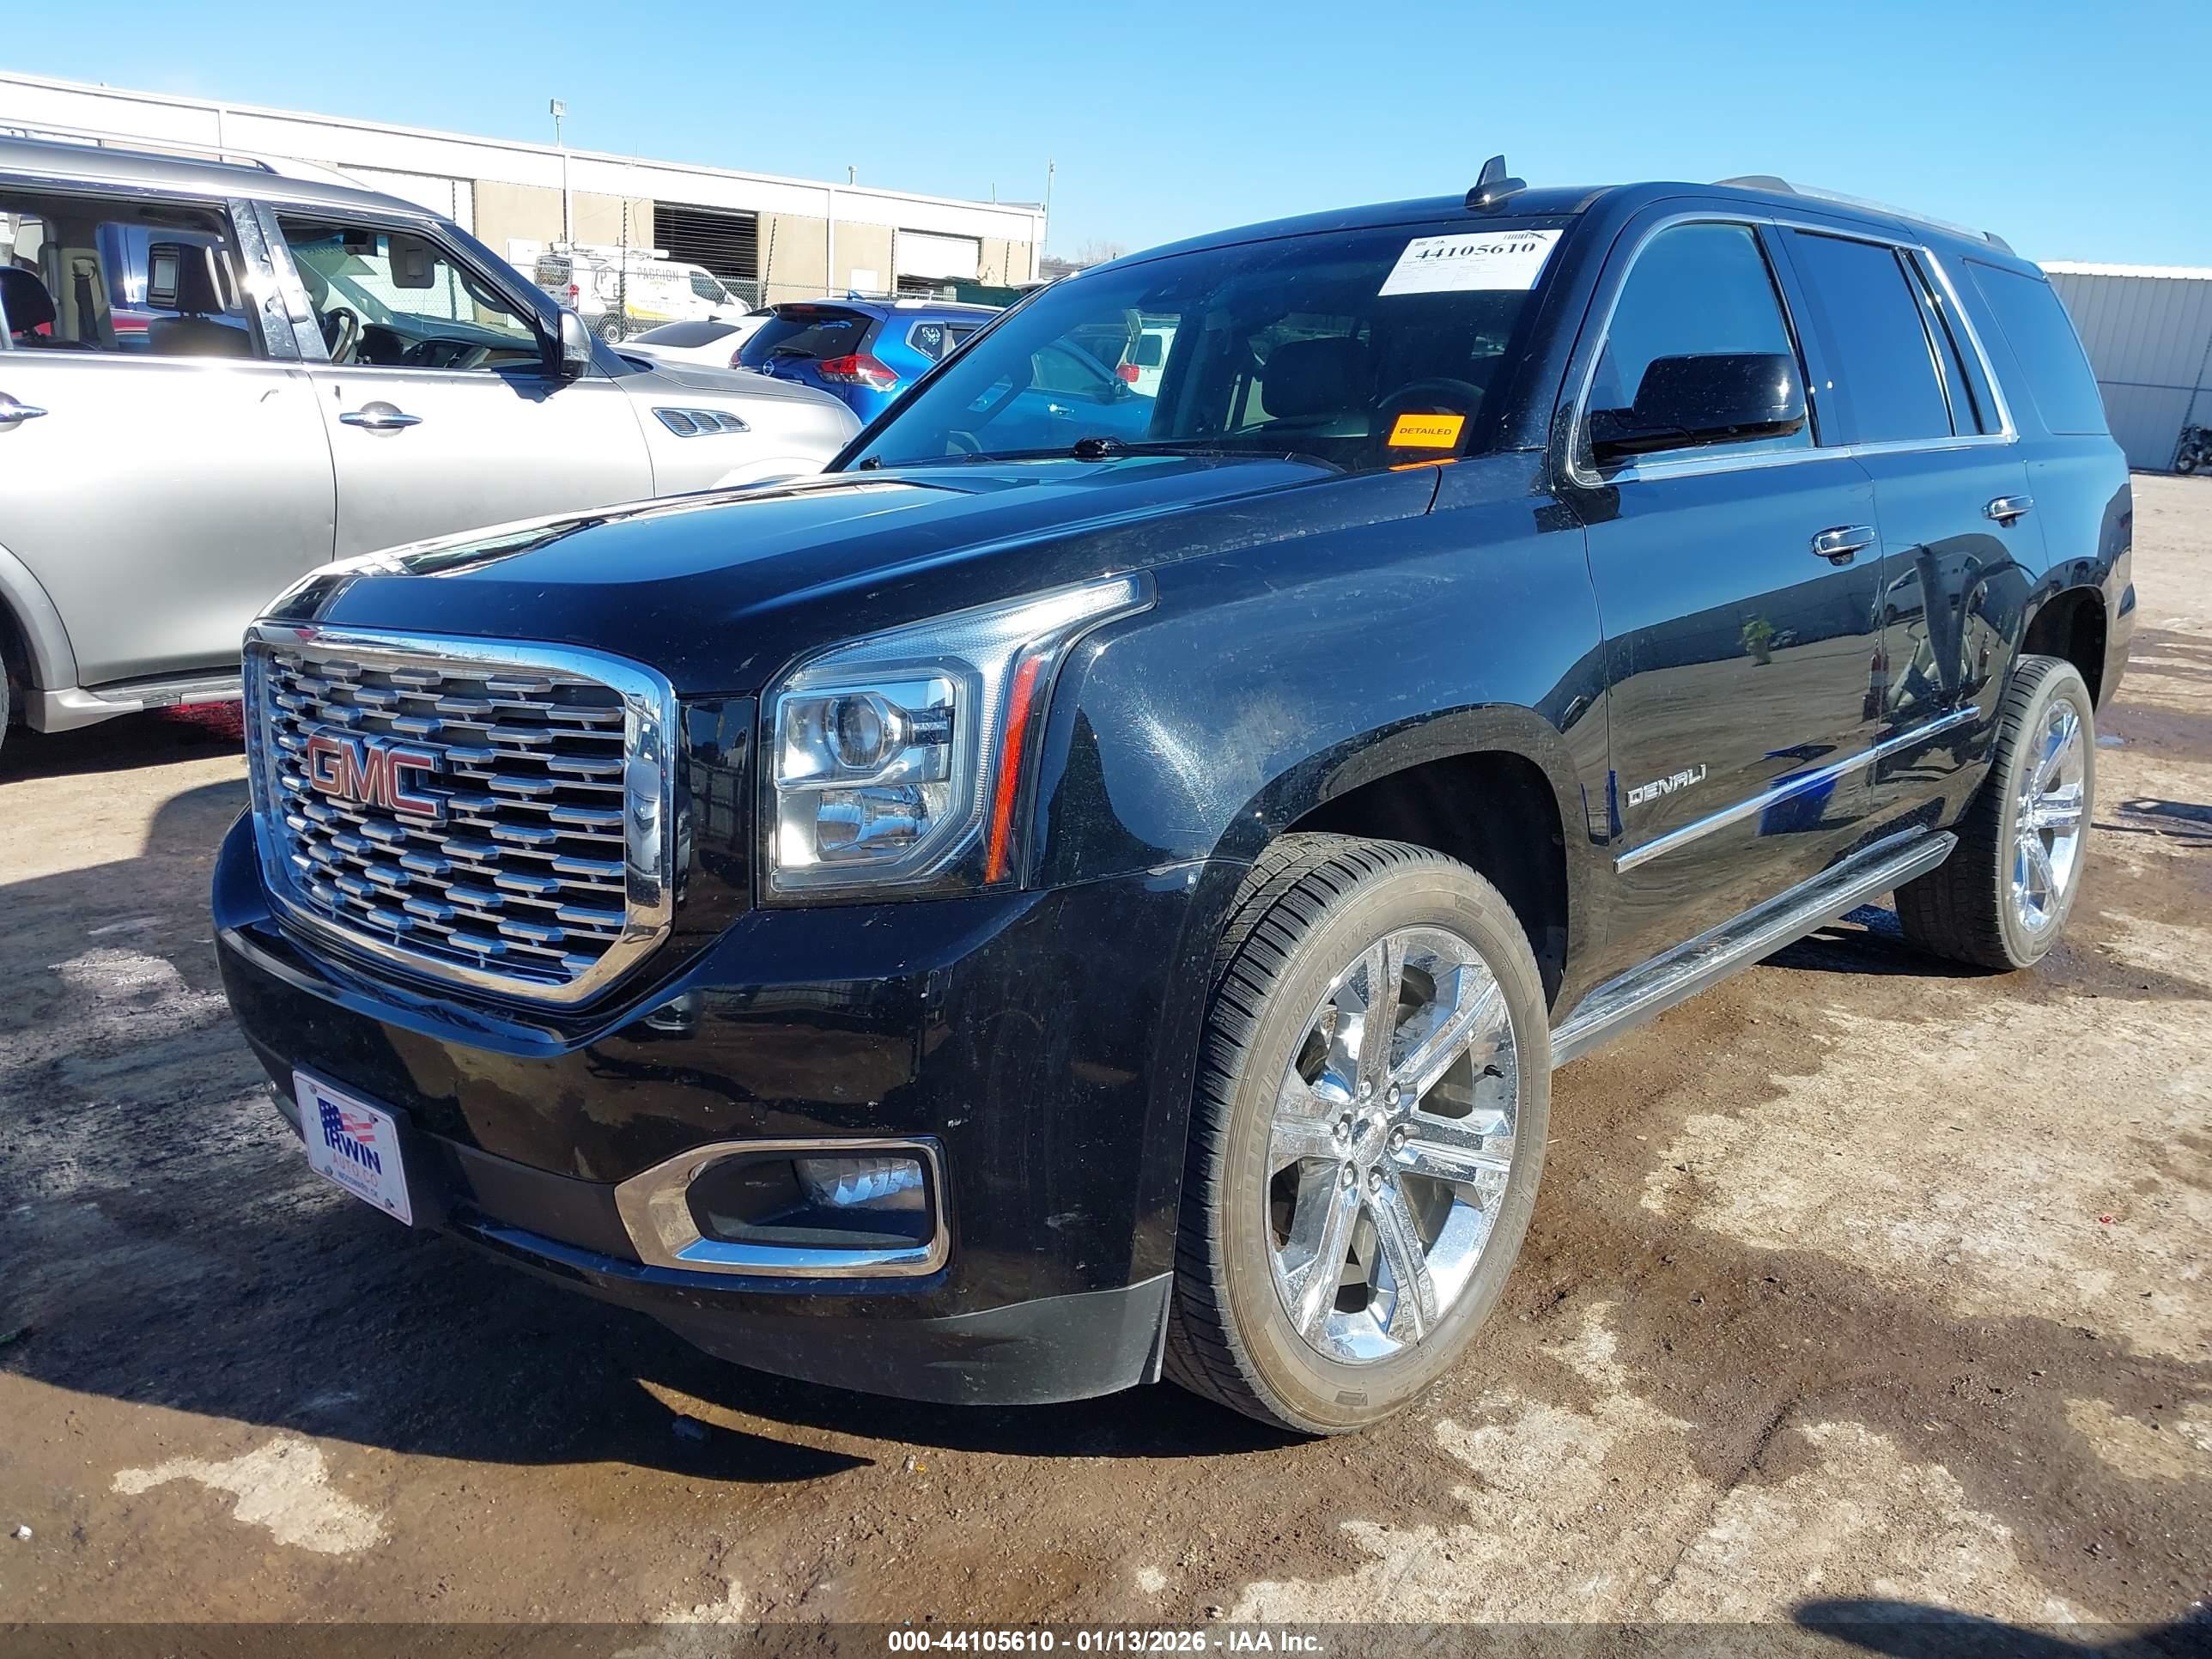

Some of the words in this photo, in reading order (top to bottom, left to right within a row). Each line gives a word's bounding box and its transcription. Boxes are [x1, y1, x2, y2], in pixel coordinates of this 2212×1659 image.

[1415, 242, 1536, 259] 44105610
[308, 732, 438, 817] GMC
[1627, 763, 1706, 808] DENALI
[323, 1128, 382, 1176] IRWIN
[332, 1152, 359, 1177] AUTO
[363, 1169, 379, 1188] CO
